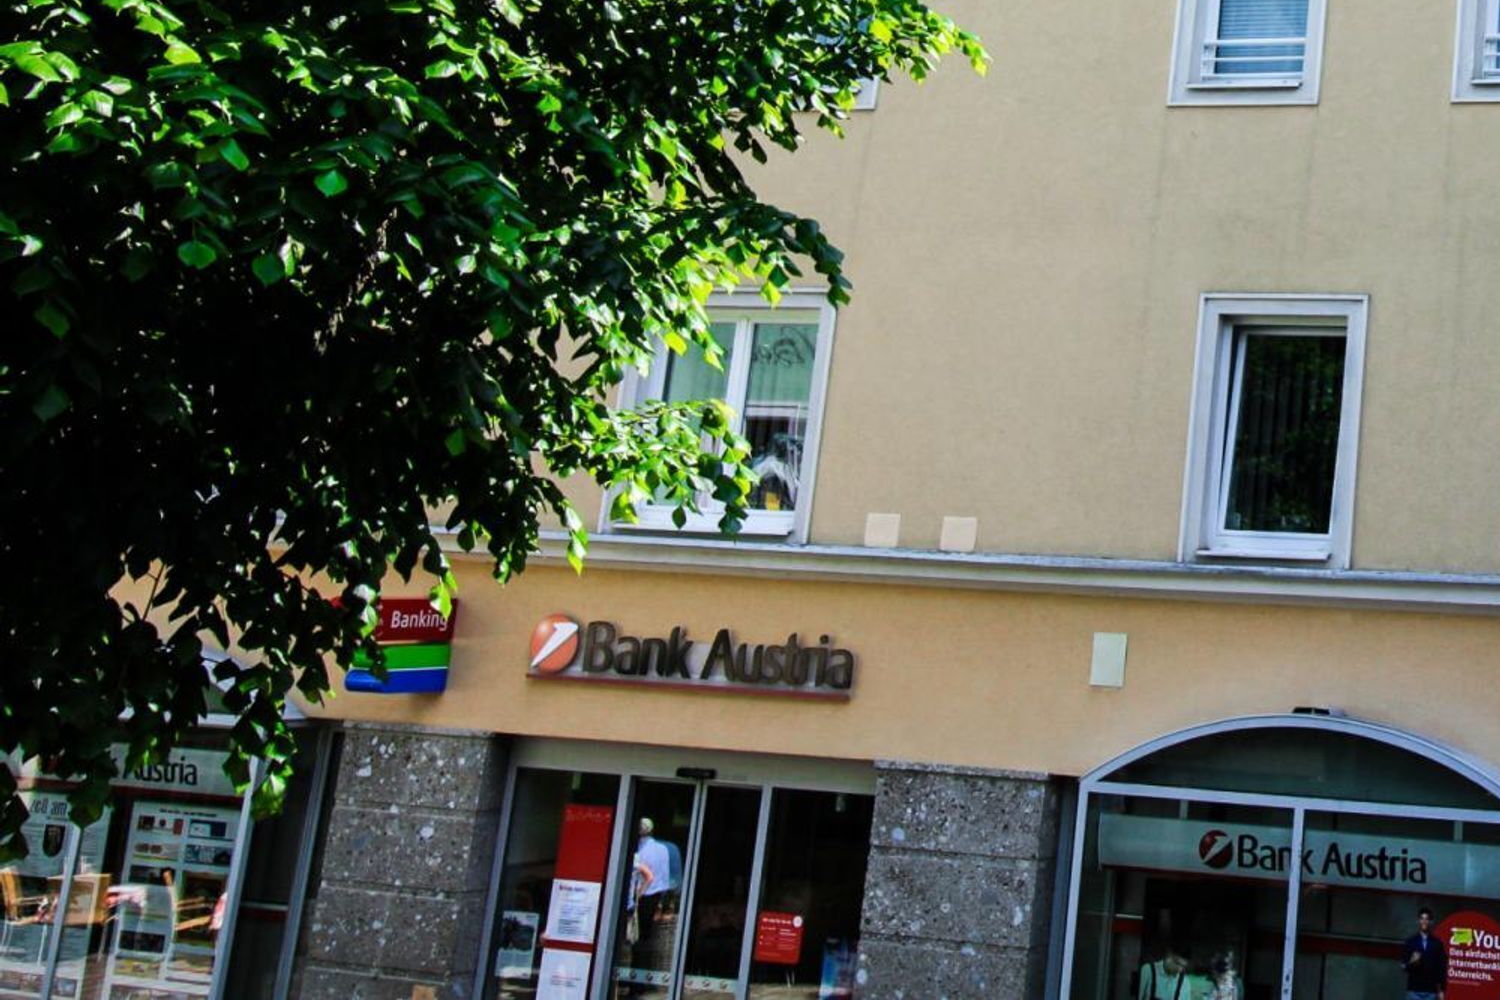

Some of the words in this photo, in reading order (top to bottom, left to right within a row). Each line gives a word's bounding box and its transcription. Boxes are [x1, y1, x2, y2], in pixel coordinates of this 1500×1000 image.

[390, 609, 449, 632] Banking
[582, 620, 694, 680] Bank
[700, 628, 854, 690] Austria
[1320, 842, 1427, 884] Austria
